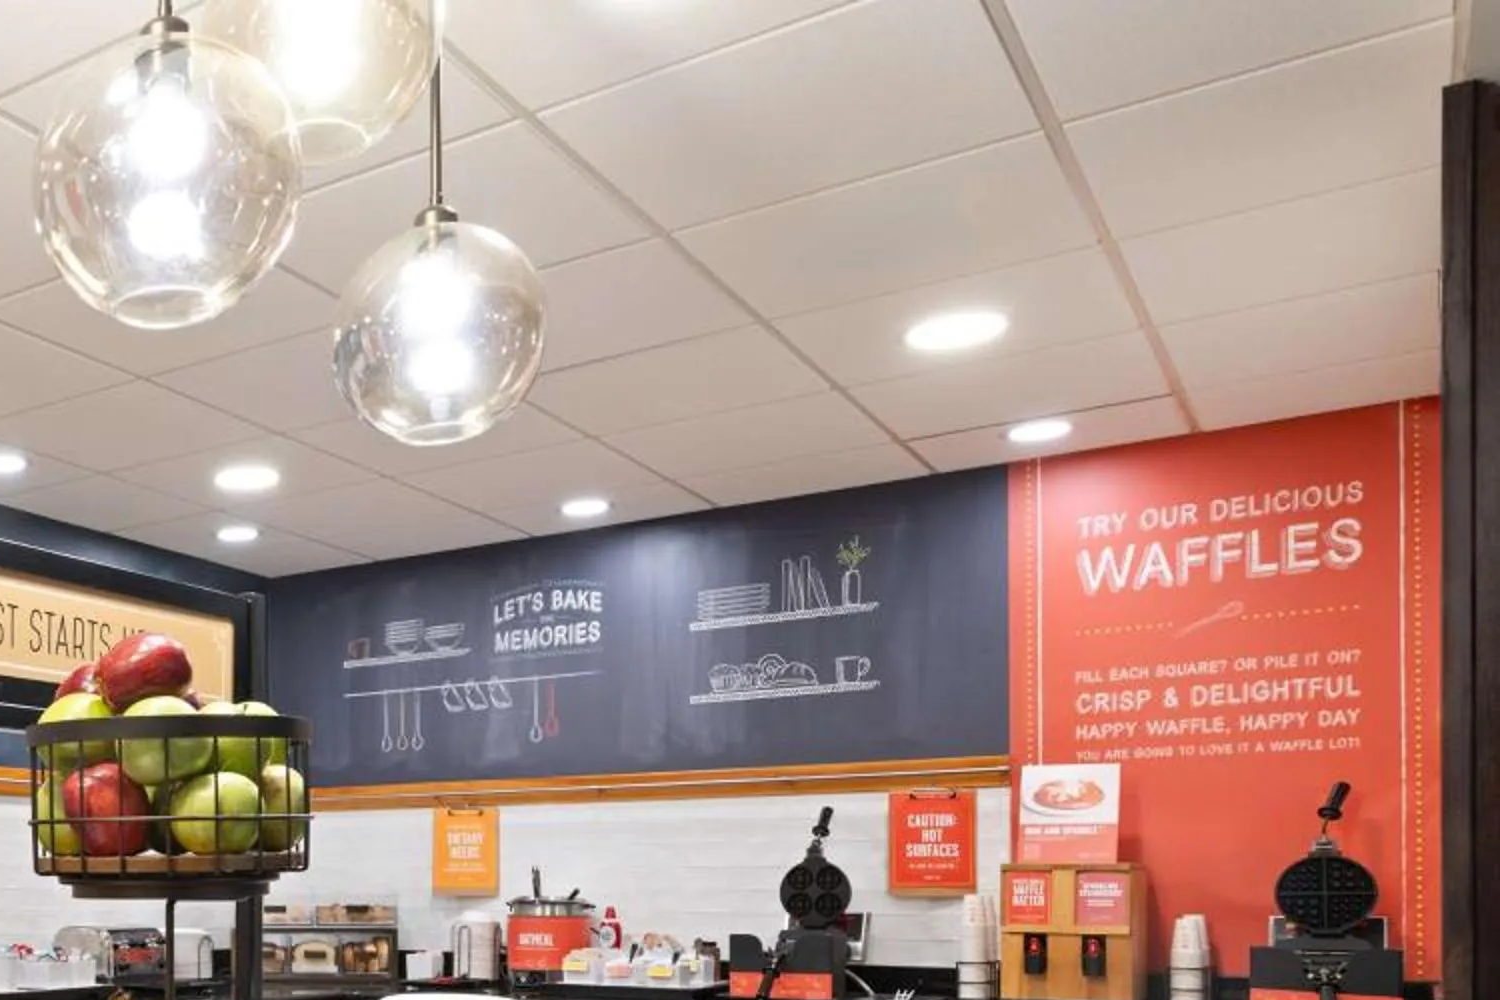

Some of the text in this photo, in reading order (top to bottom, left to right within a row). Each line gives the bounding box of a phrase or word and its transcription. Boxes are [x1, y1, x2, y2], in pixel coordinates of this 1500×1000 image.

[1077, 480, 1364, 540] TRY OUR DELICIOUS
[1077, 518, 1363, 596] WAFFLES
[493, 589, 603, 625] LET'S BAKE
[494, 620, 601, 652] MEMORIES
[1075, 649, 1361, 684] FILL EACH SQUARE? OR PILE IT ON?
[1075, 674, 1361, 714] CRISP & DELIGHTFUL
[1075, 708, 1360, 740] HAPPY WAFFLE, HAPPY DAY
[1104, 748, 1129, 760] ARE
[1180, 745, 1195, 757] TO
[1200, 743, 1233, 756] LOVE
[1237, 742, 1248, 753] IT
[1255, 741, 1265, 753] A
[1270, 739, 1323, 752] WAFFLE
[905, 843, 959, 857] SURFACES
[921, 829, 943, 843] HOT
